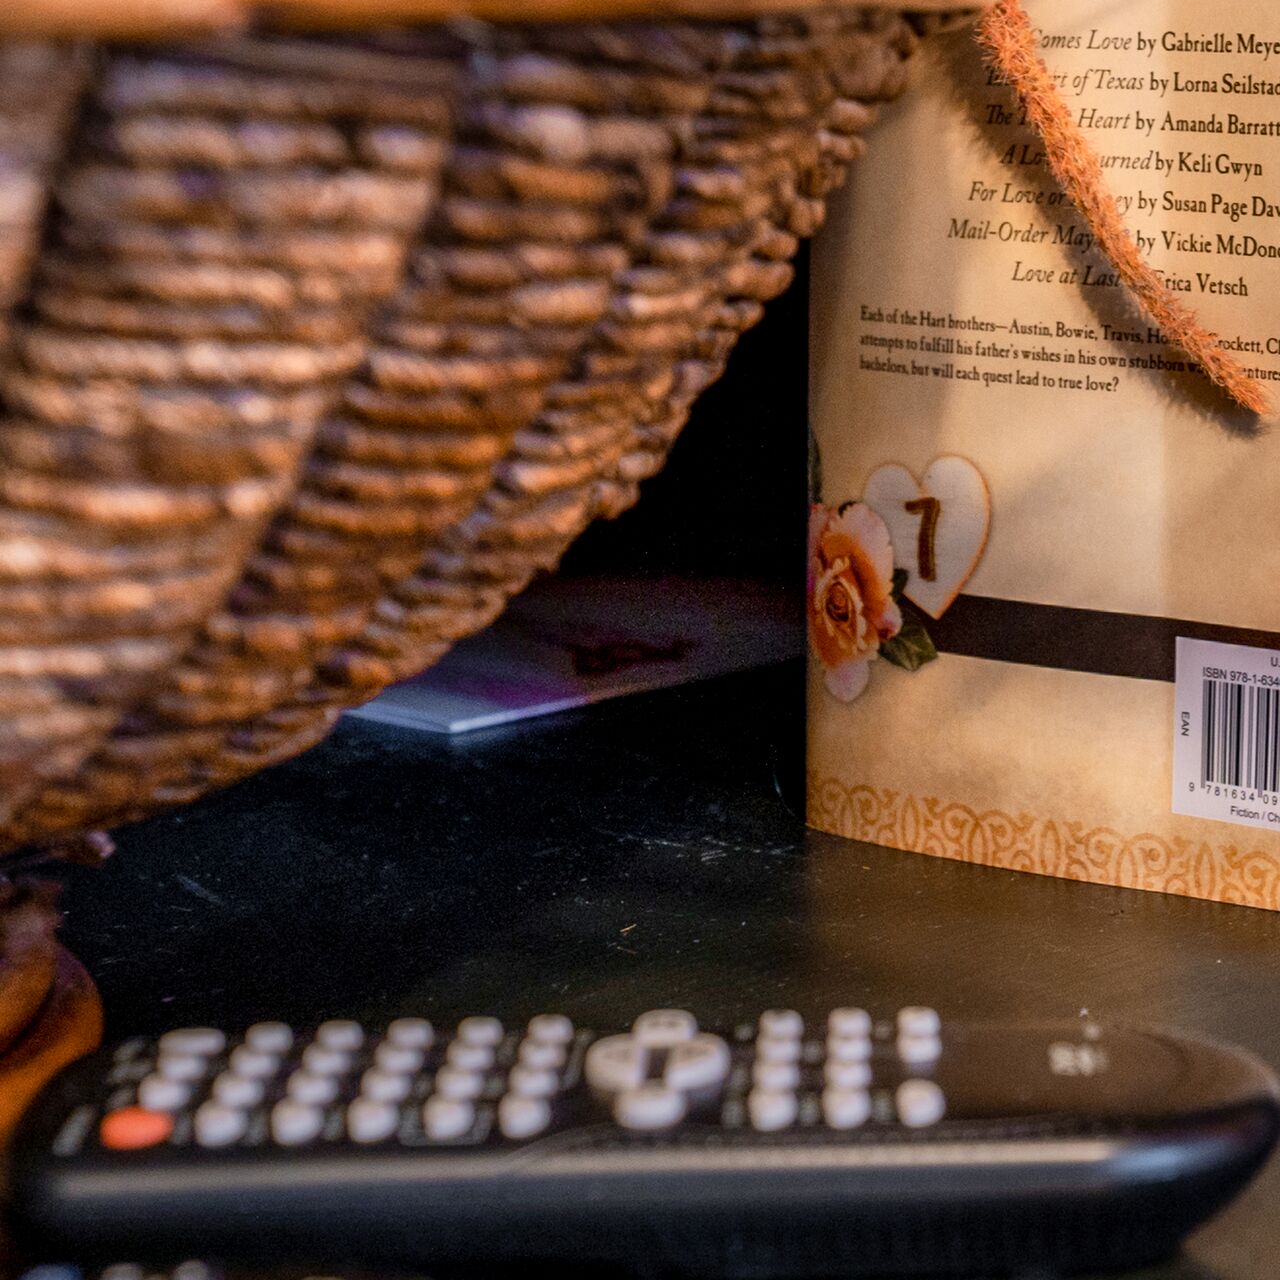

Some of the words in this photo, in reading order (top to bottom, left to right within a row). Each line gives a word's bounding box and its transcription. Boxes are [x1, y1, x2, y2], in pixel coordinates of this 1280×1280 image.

[1086, 28, 1133, 51] Love
[1136, 31, 1157, 57] by
[1161, 31, 1233, 54] Gabrielle
[1094, 69, 1144, 91] Texas
[1173, 72, 1218, 94] Lorna
[1076, 108, 1131, 130] Heart
[1159, 111, 1223, 134] Amanda
[1178, 151, 1211, 173] Keli
[1215, 154, 1262, 182] Gwyn
[968, 181, 997, 202] For
[1002, 182, 1044, 206] Love
[1162, 191, 1207, 213] Susan
[1211, 193, 1248, 222] Page
[948, 217, 1049, 246] Mail-Order
[1161, 230, 1213, 255] Vickie
[1011, 261, 1053, 285] Love
[1081, 264, 1121, 288] Last
[1196, 273, 1249, 297] Vetsch
[860, 306, 884, 323] Each
[920, 310, 946, 328] Hart
[1055, 321, 1098, 341] Bowie,
[1100, 324, 1144, 345] Travis,
[860, 335, 904, 353] attempts
[920, 336, 954, 354] fulfill
[975, 340, 1019, 359] father's
[1022, 344, 1061, 363] wishes
[1128, 351, 1185, 371] stubborn
[859, 355, 909, 375] bachelors,
[956, 366, 980, 382] each
[982, 371, 1013, 388] quest
[1016, 370, 1039, 386] lead
[1058, 377, 1082, 390] true
[1085, 376, 1119, 393] love?
[904, 496, 941, 582] 7
[1202, 666, 1227, 680] ISBN
[1181, 710, 1191, 737] EAN
[1229, 805, 1260, 820] Fiction
